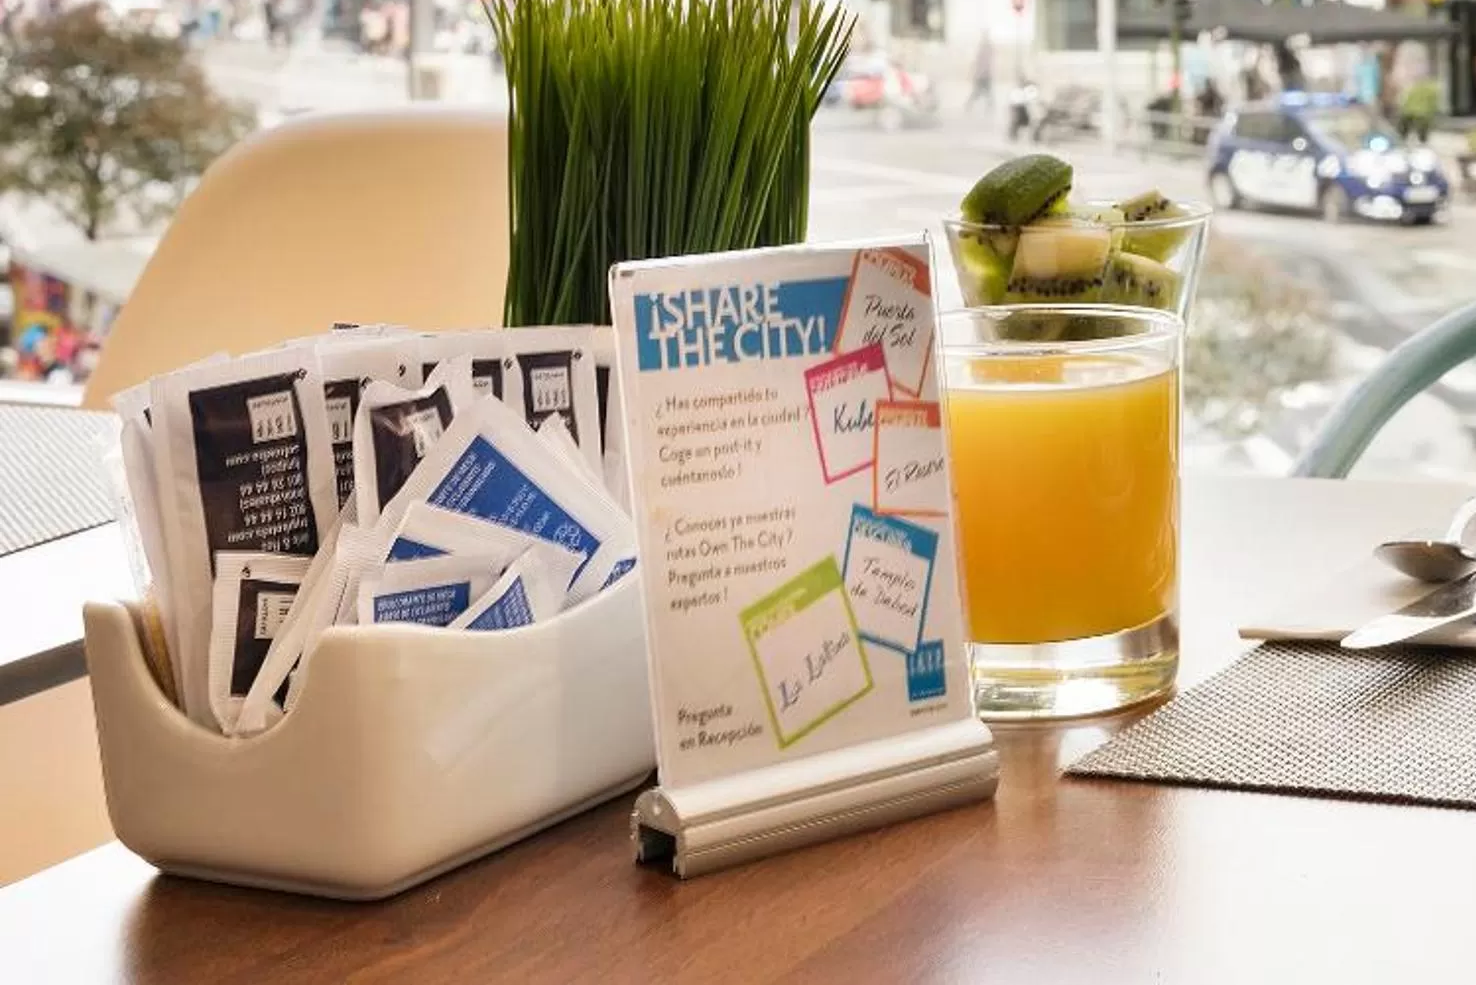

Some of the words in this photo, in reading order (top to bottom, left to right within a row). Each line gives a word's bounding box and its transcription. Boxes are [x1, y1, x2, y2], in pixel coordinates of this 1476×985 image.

[649, 281, 783, 336] ¡SHARE
[865, 294, 916, 320] Puerta
[649, 325, 729, 368] THE
[733, 315, 826, 361] CITY!
[861, 324, 886, 347] del
[889, 322, 916, 349] Sol
[692, 389, 762, 412] compartido
[764, 387, 778, 402] tu
[656, 419, 728, 440] experiencia
[730, 416, 745, 429] en
[747, 411, 759, 426] la
[658, 443, 693, 466] Coge
[695, 445, 711, 458] un
[755, 439, 763, 451] y
[730, 515, 743, 532] ya
[745, 507, 796, 525] nuestras
[666, 545, 697, 561] rutas
[699, 538, 729, 558] Own
[731, 534, 755, 555] The
[668, 565, 722, 589] Pregunta
[734, 557, 787, 576] nuestros
[850, 577, 868, 598] de
[778, 675, 803, 713] La
[803, 631, 851, 683] Latina
[678, 704, 733, 726] Pregunta
[679, 736, 697, 751] en
